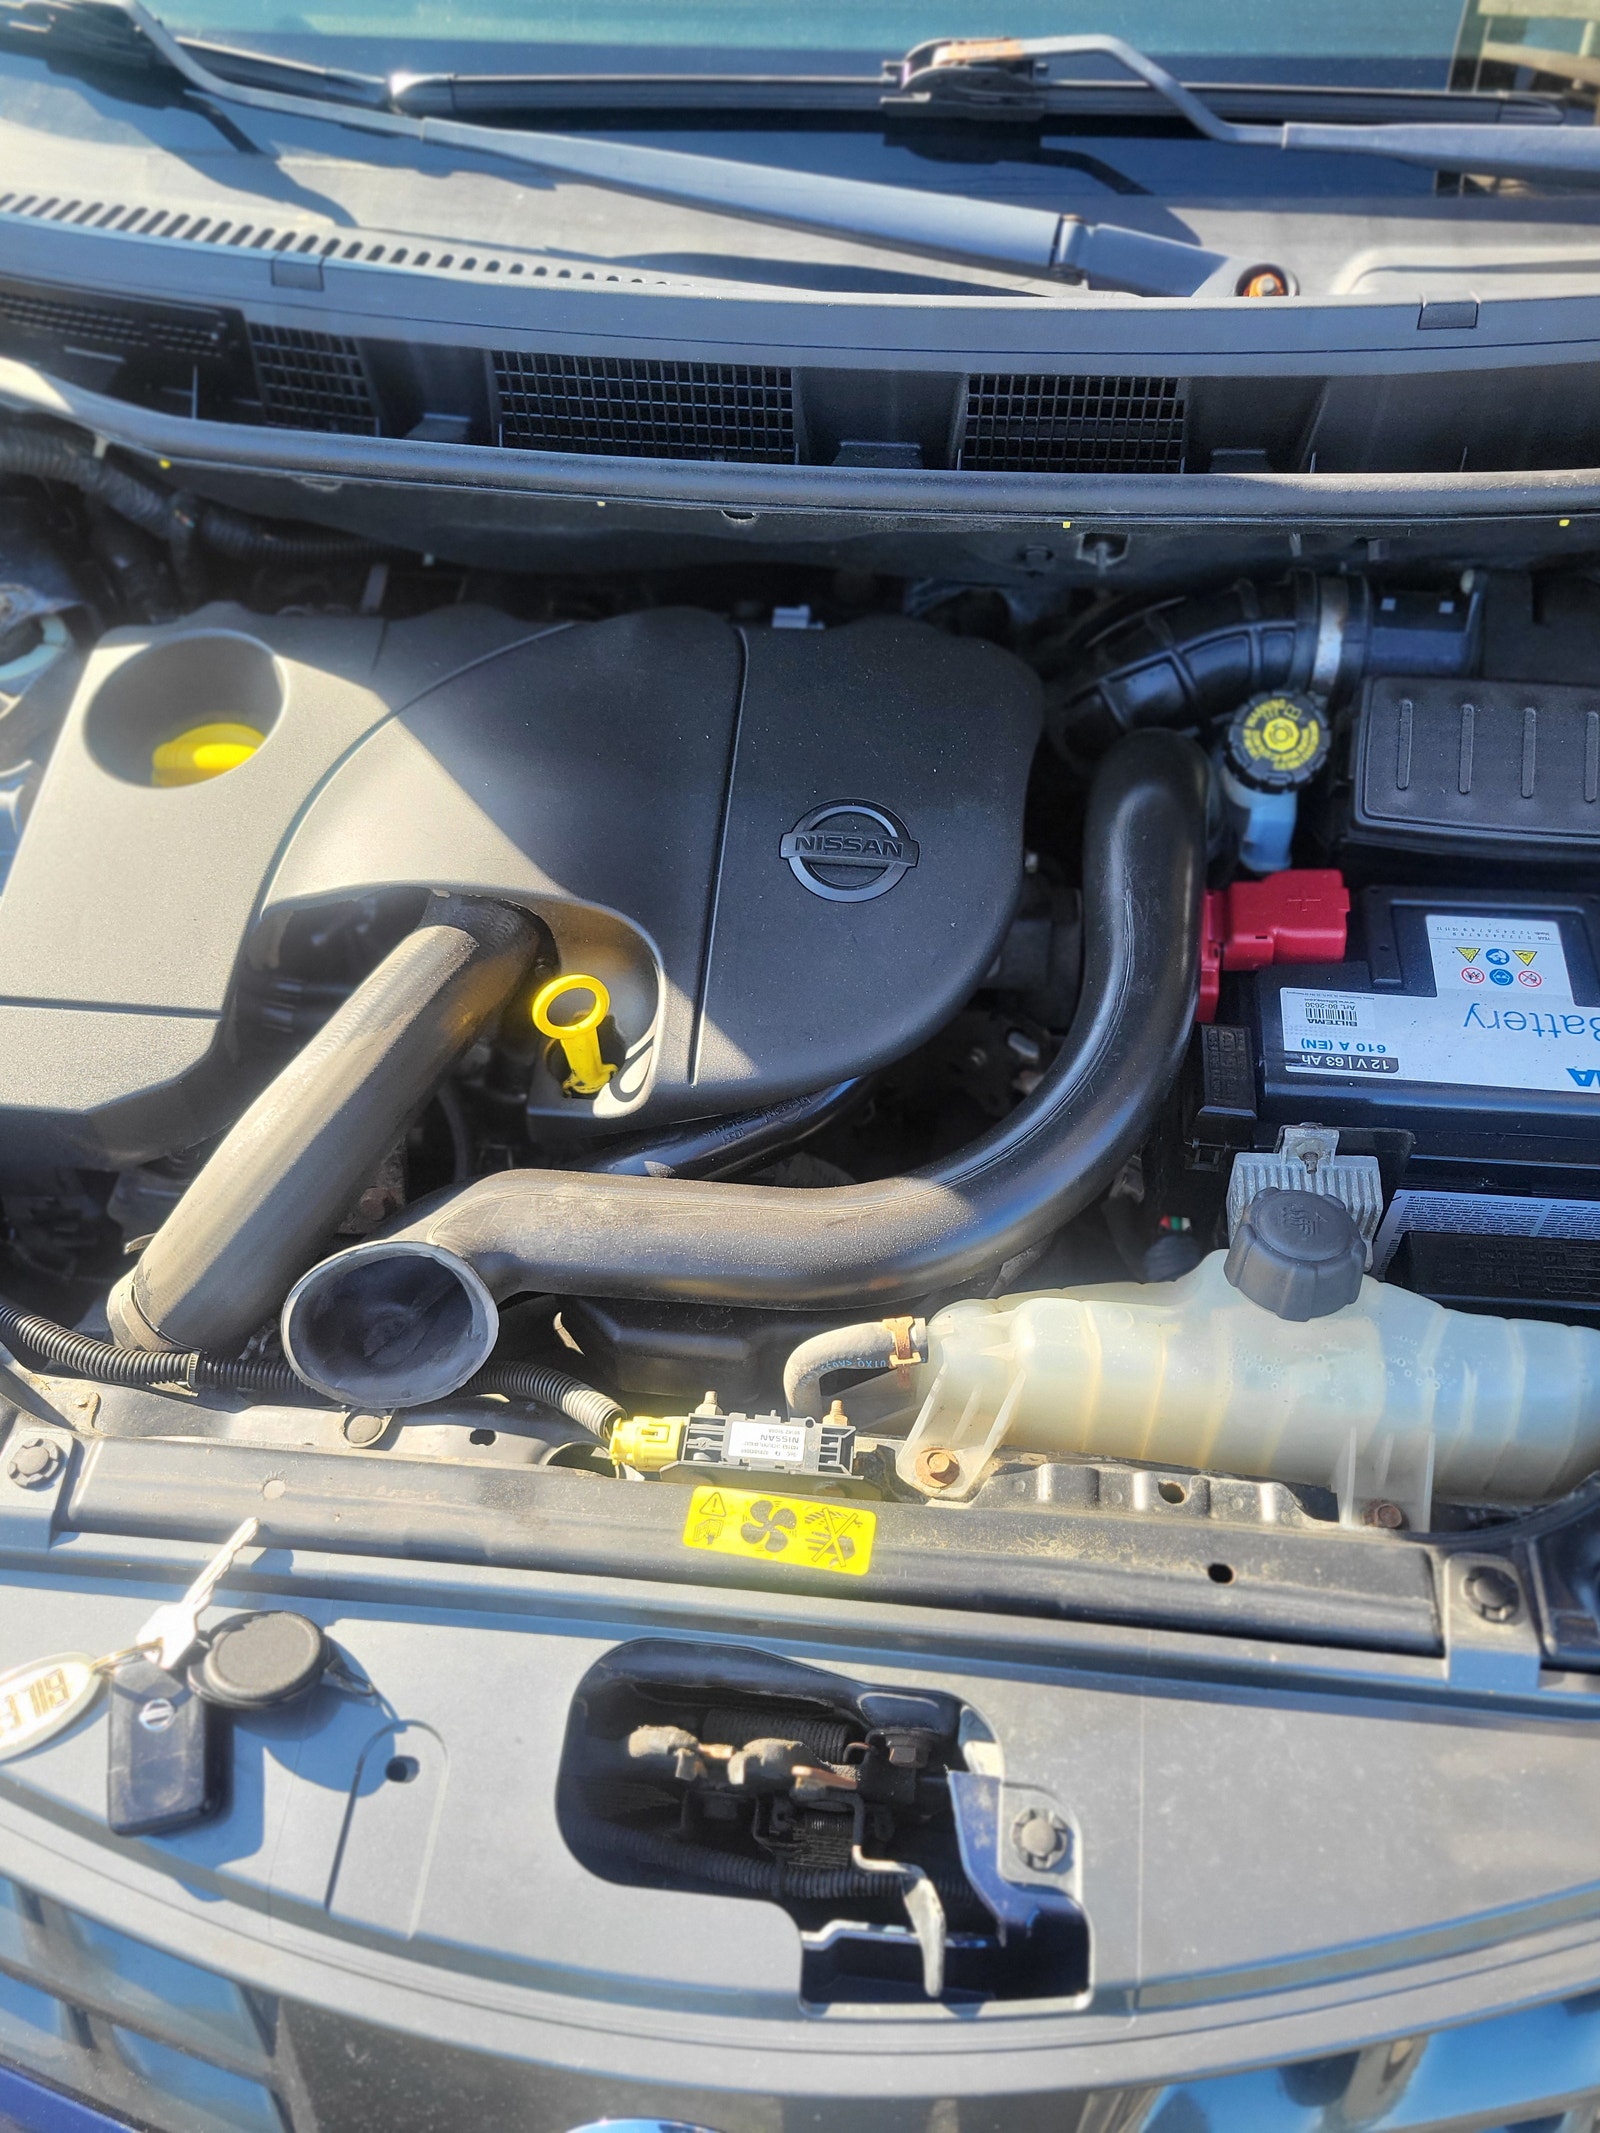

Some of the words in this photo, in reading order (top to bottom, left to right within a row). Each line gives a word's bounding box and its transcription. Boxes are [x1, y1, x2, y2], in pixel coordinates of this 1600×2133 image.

[795, 834, 904, 858] NISSAN
[1306, 1018, 1358, 1027] BILTEMA
[1300, 1038, 1333, 1051] (EN)
[1339, 1042, 1350, 1051] A
[1356, 1043, 1386, 1054] 610
[1301, 1054, 1322, 1066] Ah
[1326, 1056, 1344, 1066] 63
[1356, 1058, 1367, 1068] V
[1370, 1059, 1390, 1070] 12
[760, 1434, 800, 1444] NISSAN
